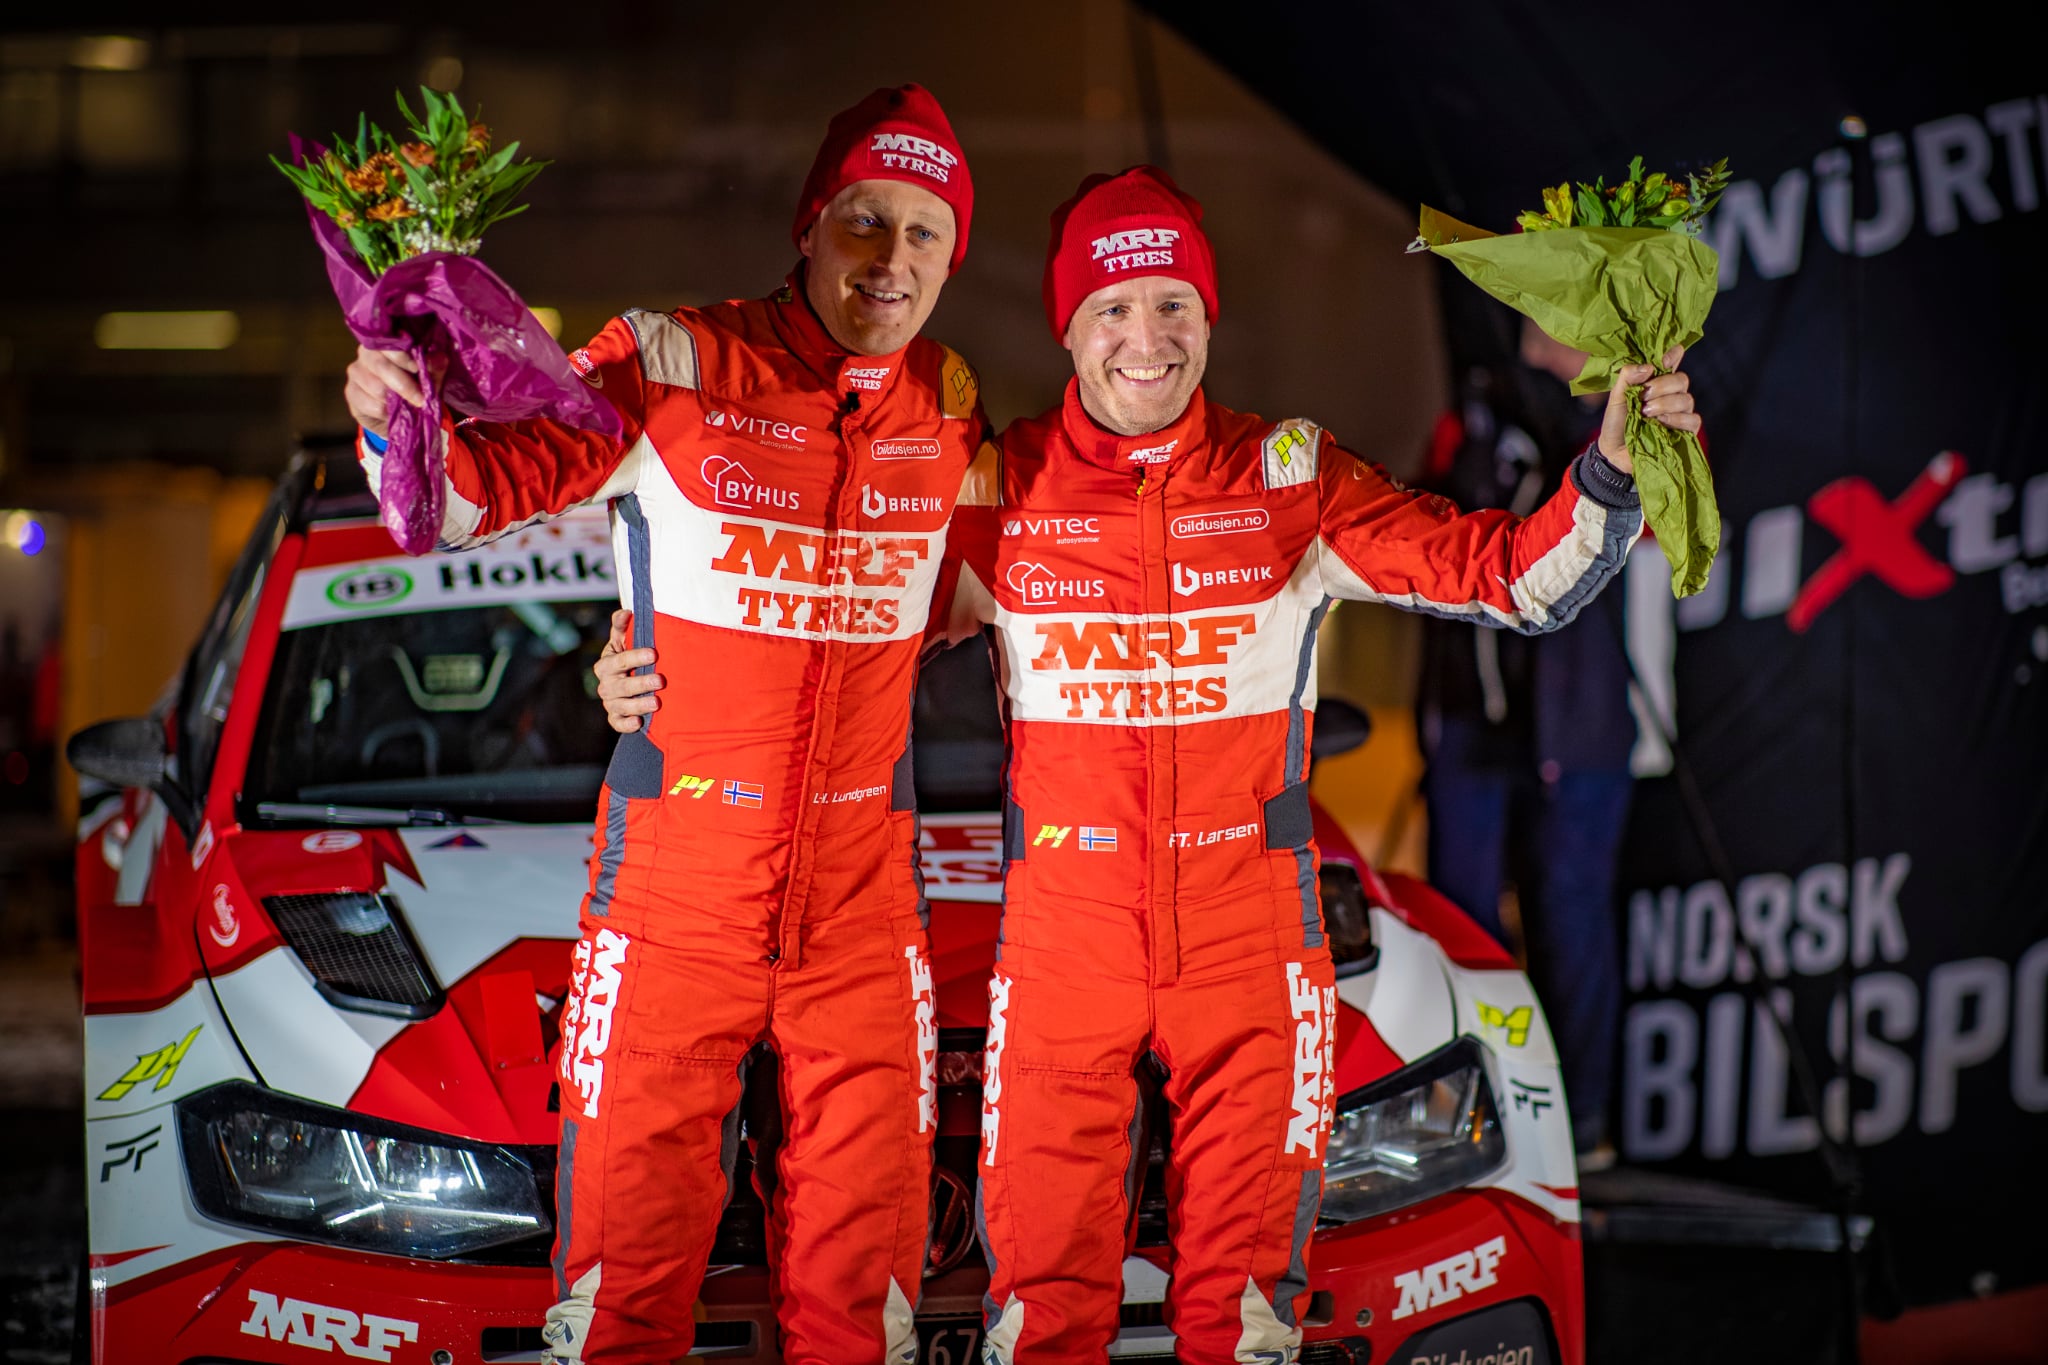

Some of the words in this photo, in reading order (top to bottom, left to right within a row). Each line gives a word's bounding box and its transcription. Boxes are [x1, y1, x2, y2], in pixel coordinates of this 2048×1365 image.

[871, 133, 958, 168] MRF
[882, 152, 949, 184] TYRES
[1702, 92, 2048, 292] WÜRT
[1091, 228, 1180, 260] MRF
[1104, 250, 1174, 273] TYRES
[844, 367, 891, 379] MRF
[850, 378, 882, 390] TYRES
[1127, 439, 1179, 461] MRF
[725, 480, 800, 510] BYHUS
[888, 496, 943, 513] BREVIK
[1178, 514, 1262, 534] bildusjen.no
[711, 522, 928, 588] MRF
[1031, 579, 1105, 599] BYHUS
[1203, 566, 1273, 587] BREVIK
[737, 587, 899, 635] TYRES
[1031, 613, 1257, 671] MRF
[1060, 676, 1228, 718] TYRES
[832, 785, 887, 802] Lundgreen
[1197, 822, 1258, 847] Larsen
[1627, 853, 1912, 994] NORSK
[574, 928, 630, 1119] MRF
[1284, 962, 1323, 1159] MRF
[1392, 1235, 1507, 1321] MRF
[239, 1288, 419, 1364] MRF
